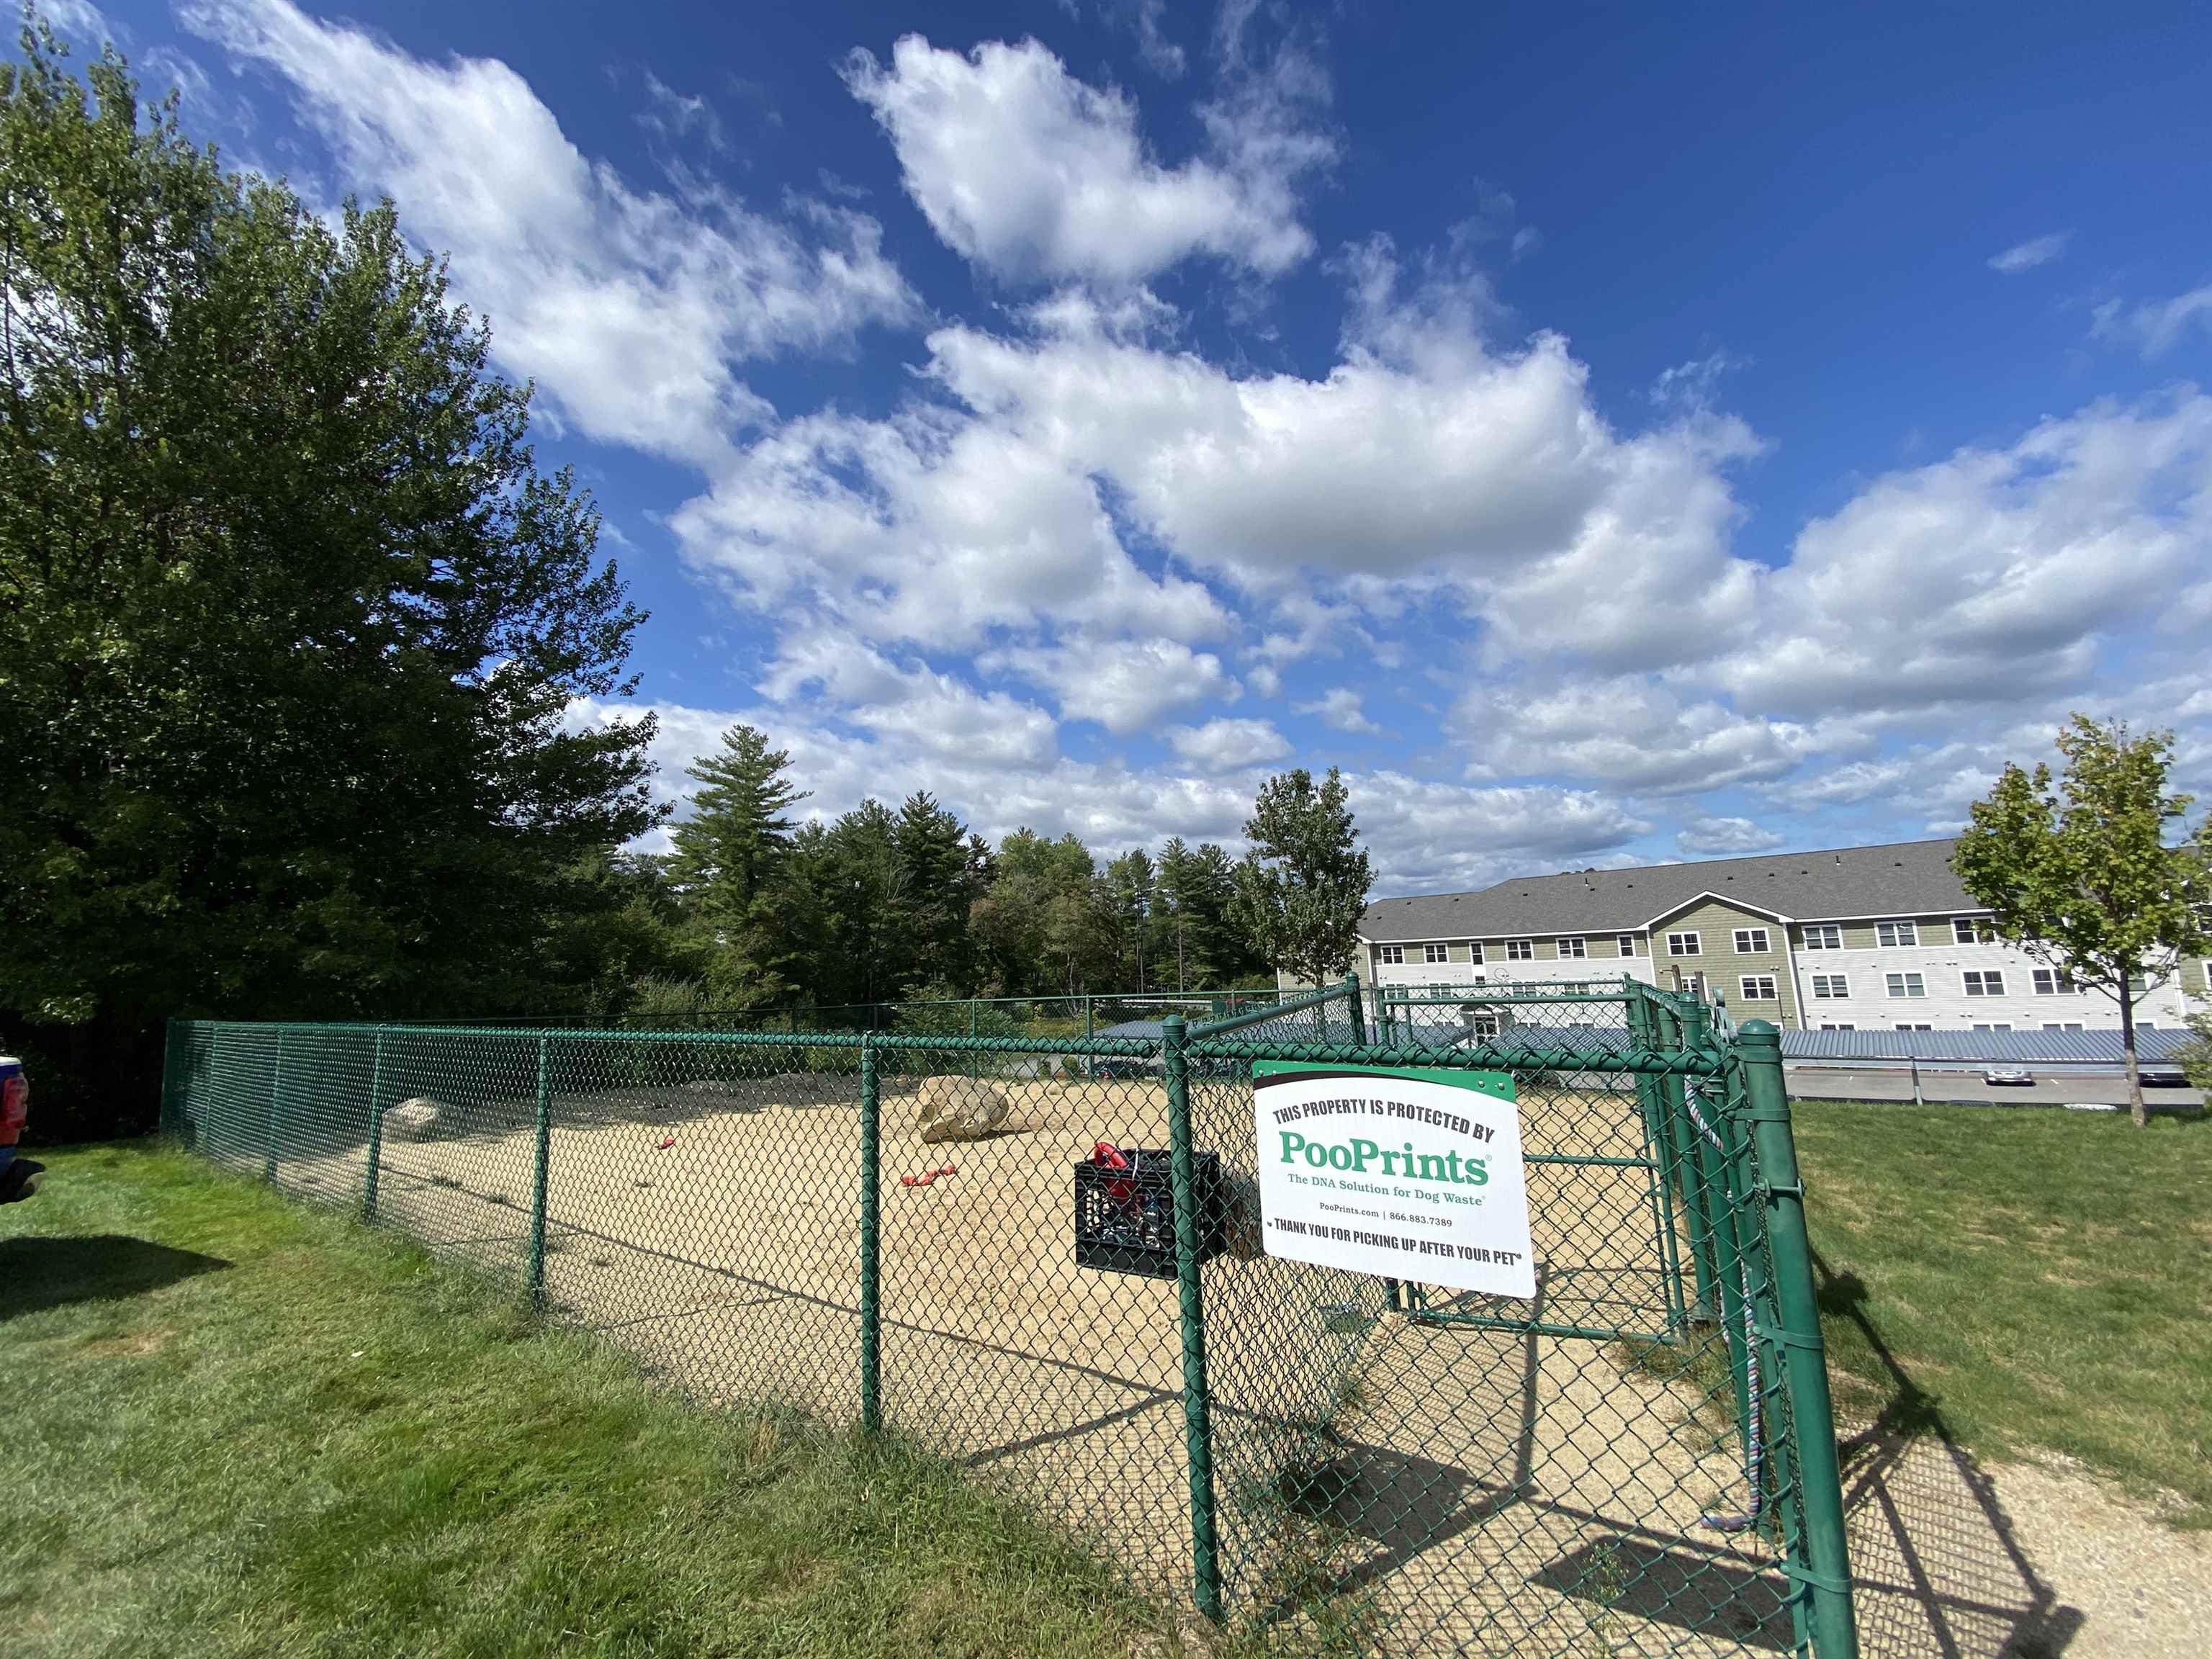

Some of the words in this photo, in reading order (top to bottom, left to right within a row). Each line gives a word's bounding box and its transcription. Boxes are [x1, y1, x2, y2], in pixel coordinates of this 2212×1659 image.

[1272, 1105, 1301, 1124] THIS
[1302, 1099, 1366, 1118] PROPERTY
[1370, 1099, 1384, 1115] IS
[1387, 1101, 1470, 1135] PROTECTED
[1472, 1123, 1496, 1143] BY
[1287, 1173, 1308, 1184] The
[1311, 1176, 1337, 1189] DNA
[1339, 1180, 1390, 1195] Solution
[1393, 1186, 1411, 1198] for
[1414, 1189, 1440, 1204] Dog
[1442, 1192, 1483, 1206] Waste
[1319, 1202, 1380, 1218] PooPrints.com
[1389, 1212, 1452, 1228] 866.883.7389
[1274, 1217, 1307, 1235] THANK
[1308, 1223, 1328, 1238] YOU
[1331, 1226, 1351, 1242] FOR
[1353, 1230, 1399, 1250] PICKING
[1401, 1237, 1416, 1252] UP
[1419, 1240, 1455, 1258] AFTER
[1457, 1244, 1491, 1263] YOUR
[1493, 1249, 1515, 1267] PET
